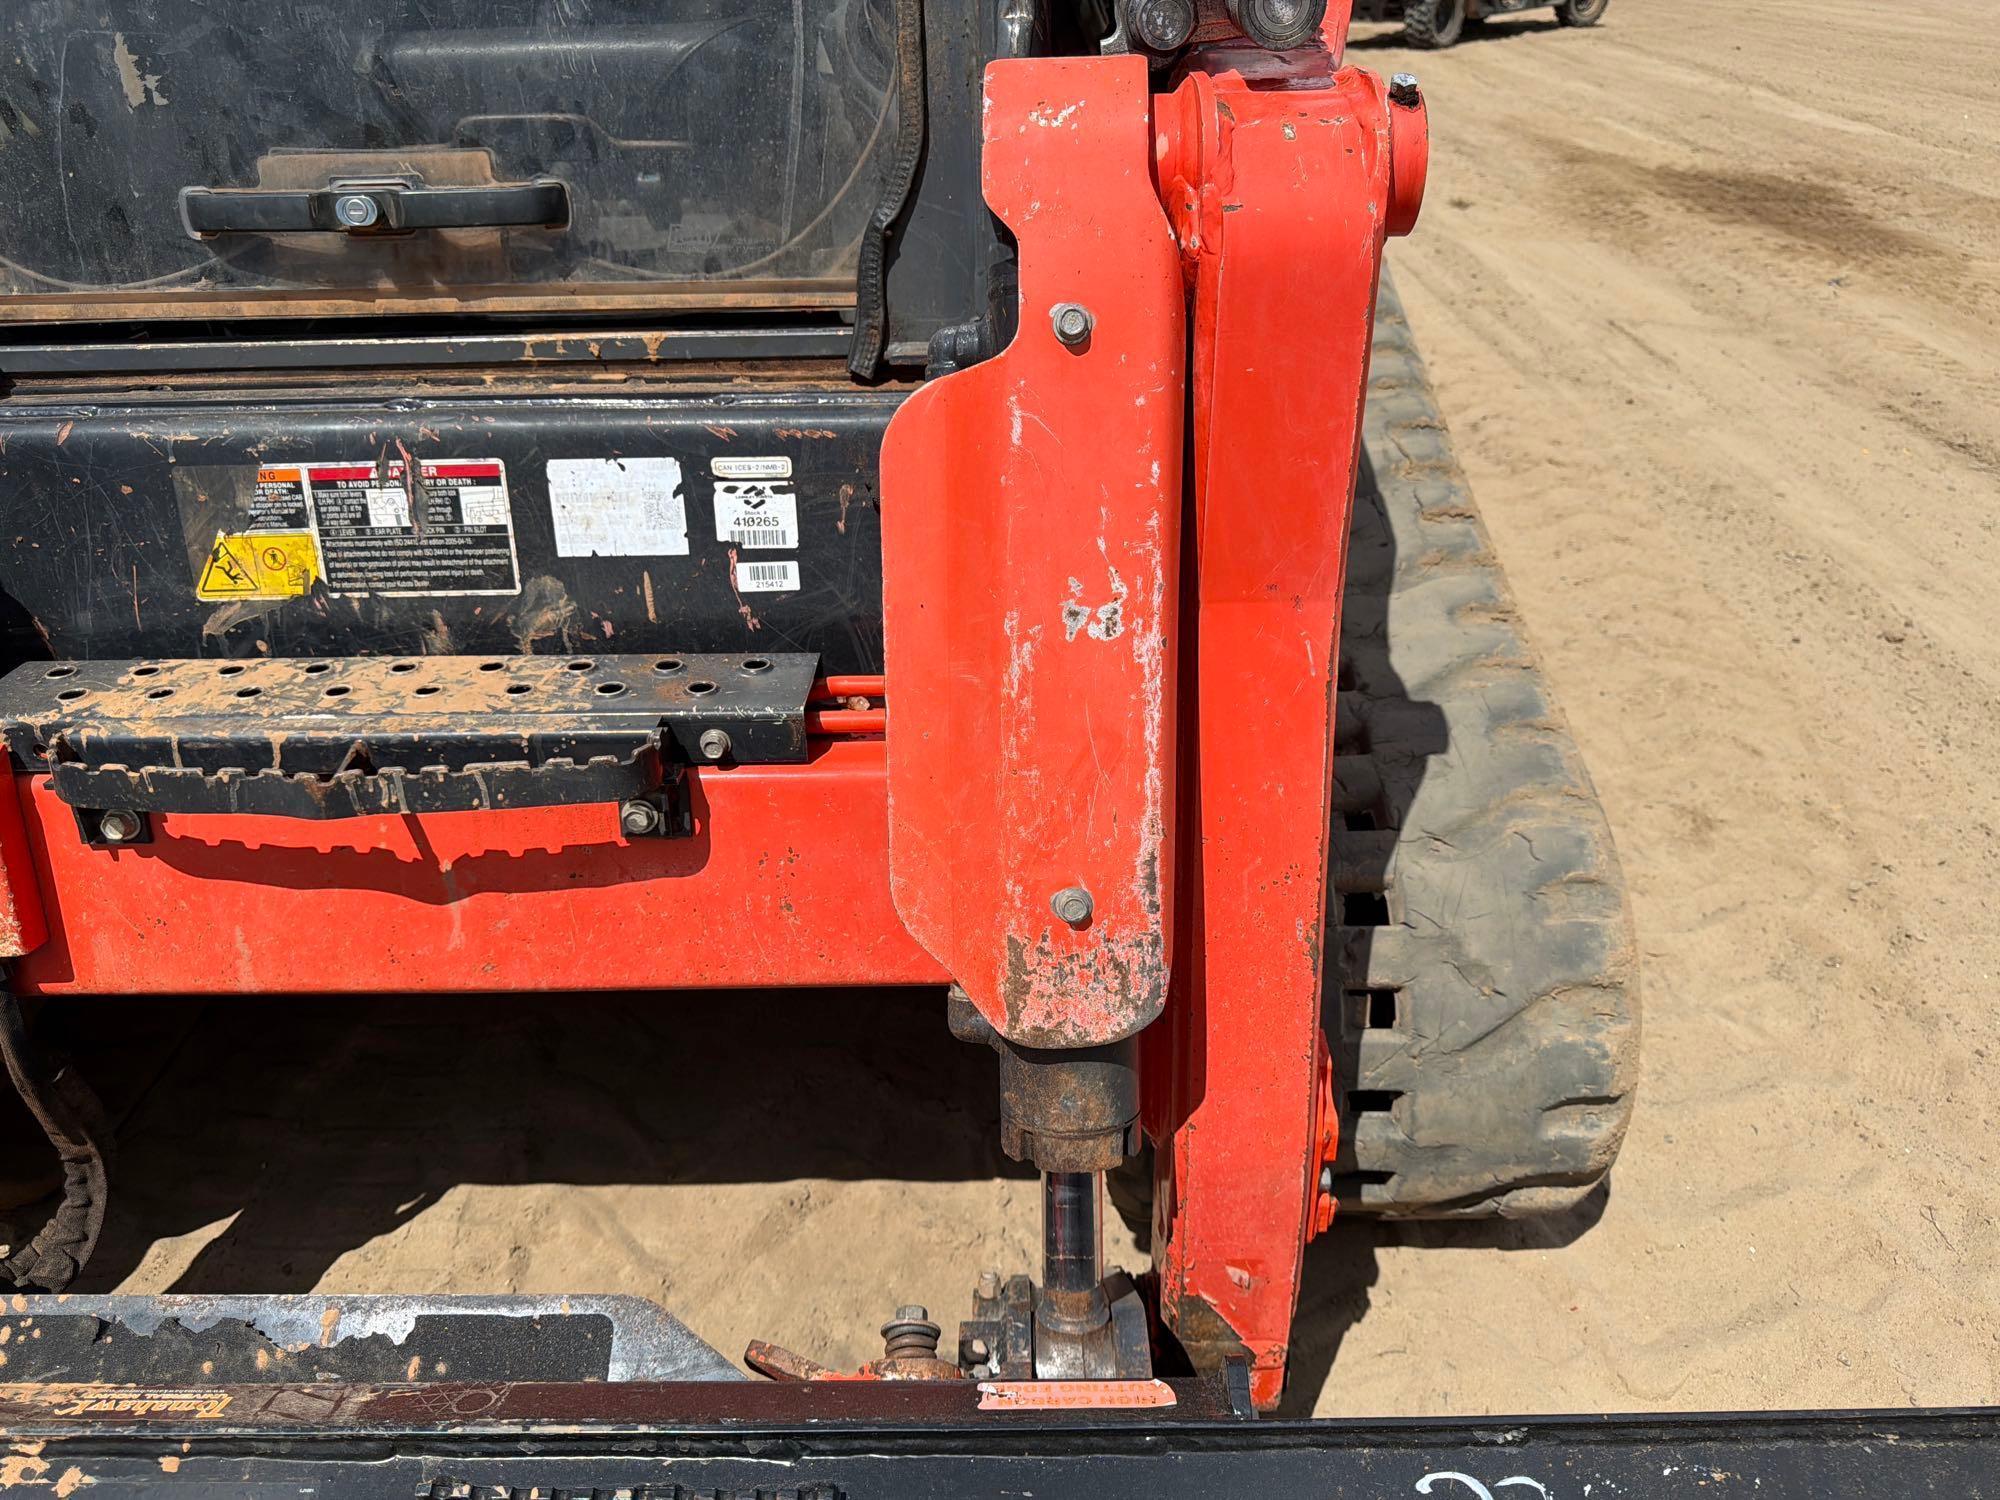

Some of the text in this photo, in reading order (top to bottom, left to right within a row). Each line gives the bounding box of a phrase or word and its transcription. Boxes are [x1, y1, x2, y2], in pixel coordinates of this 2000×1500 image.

[718, 464, 733, 472] CAN
[348, 480, 370, 488] AVOID
[436, 478, 446, 486] OR
[448, 478, 472, 486] DEATH
[386, 527, 402, 535] PLATE
